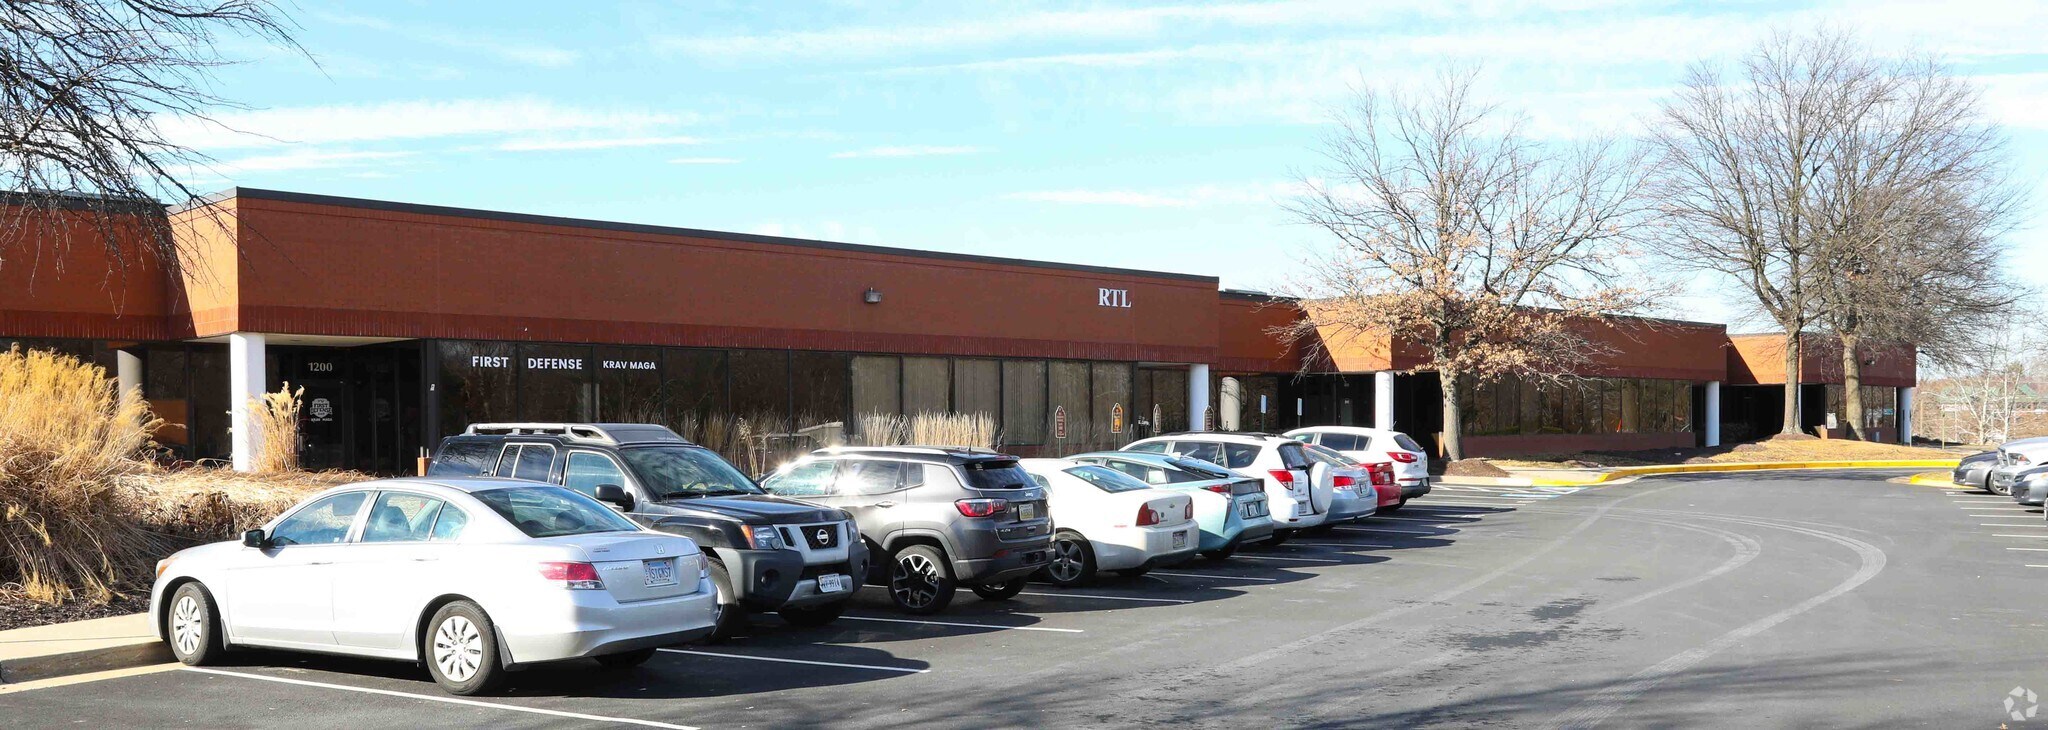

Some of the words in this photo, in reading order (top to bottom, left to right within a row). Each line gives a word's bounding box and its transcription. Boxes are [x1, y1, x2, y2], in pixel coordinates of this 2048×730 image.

[1098, 287, 1131, 308] RTL
[308, 362, 333, 371] 1200
[472, 356, 509, 368] FIRST
[527, 358, 583, 370] DEFENSE
[603, 360, 627, 369] KRAV
[629, 361, 656, 370] MAGA
